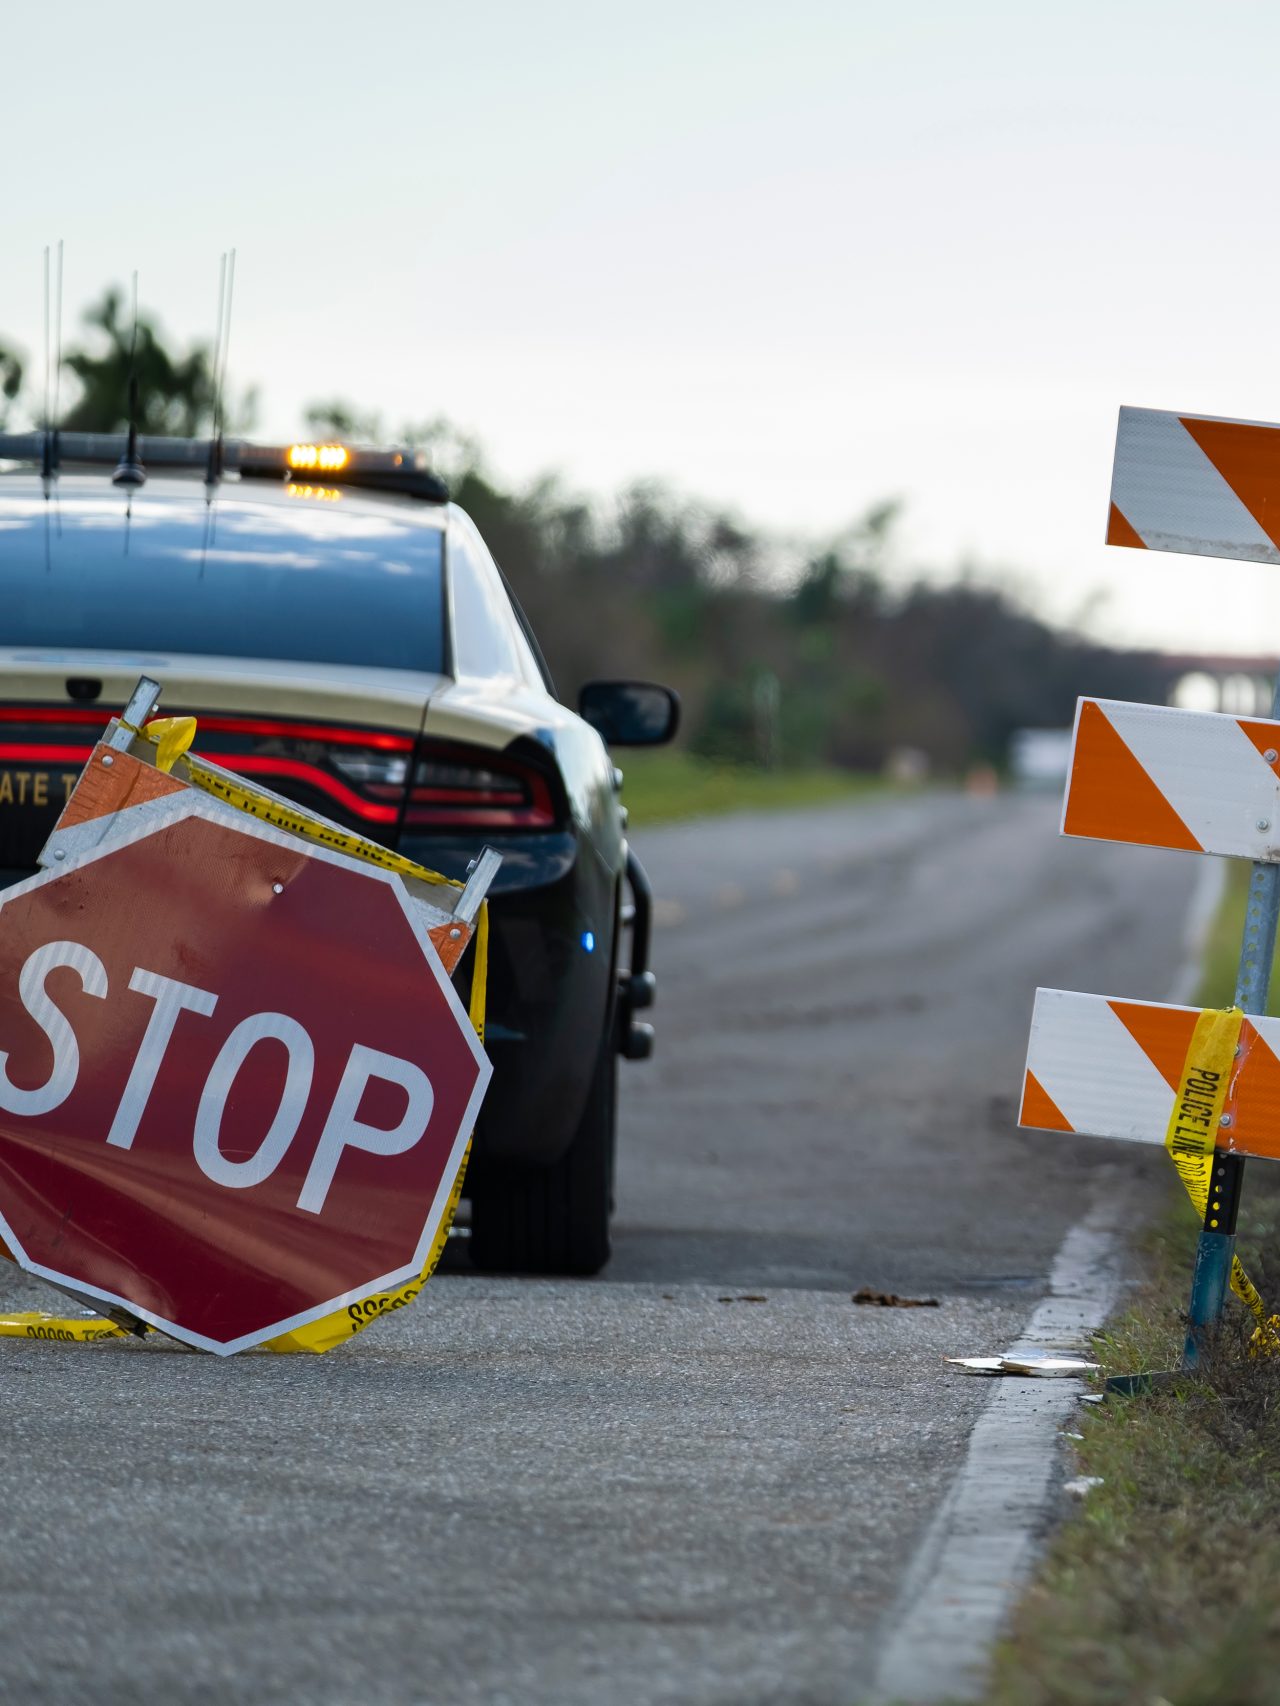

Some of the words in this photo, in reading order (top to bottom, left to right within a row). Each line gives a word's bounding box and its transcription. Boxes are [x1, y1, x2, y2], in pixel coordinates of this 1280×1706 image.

[0, 940, 434, 1215] STOP
[1178, 1066, 1220, 1127] POLICE
[1171, 1125, 1208, 1159] LINE
